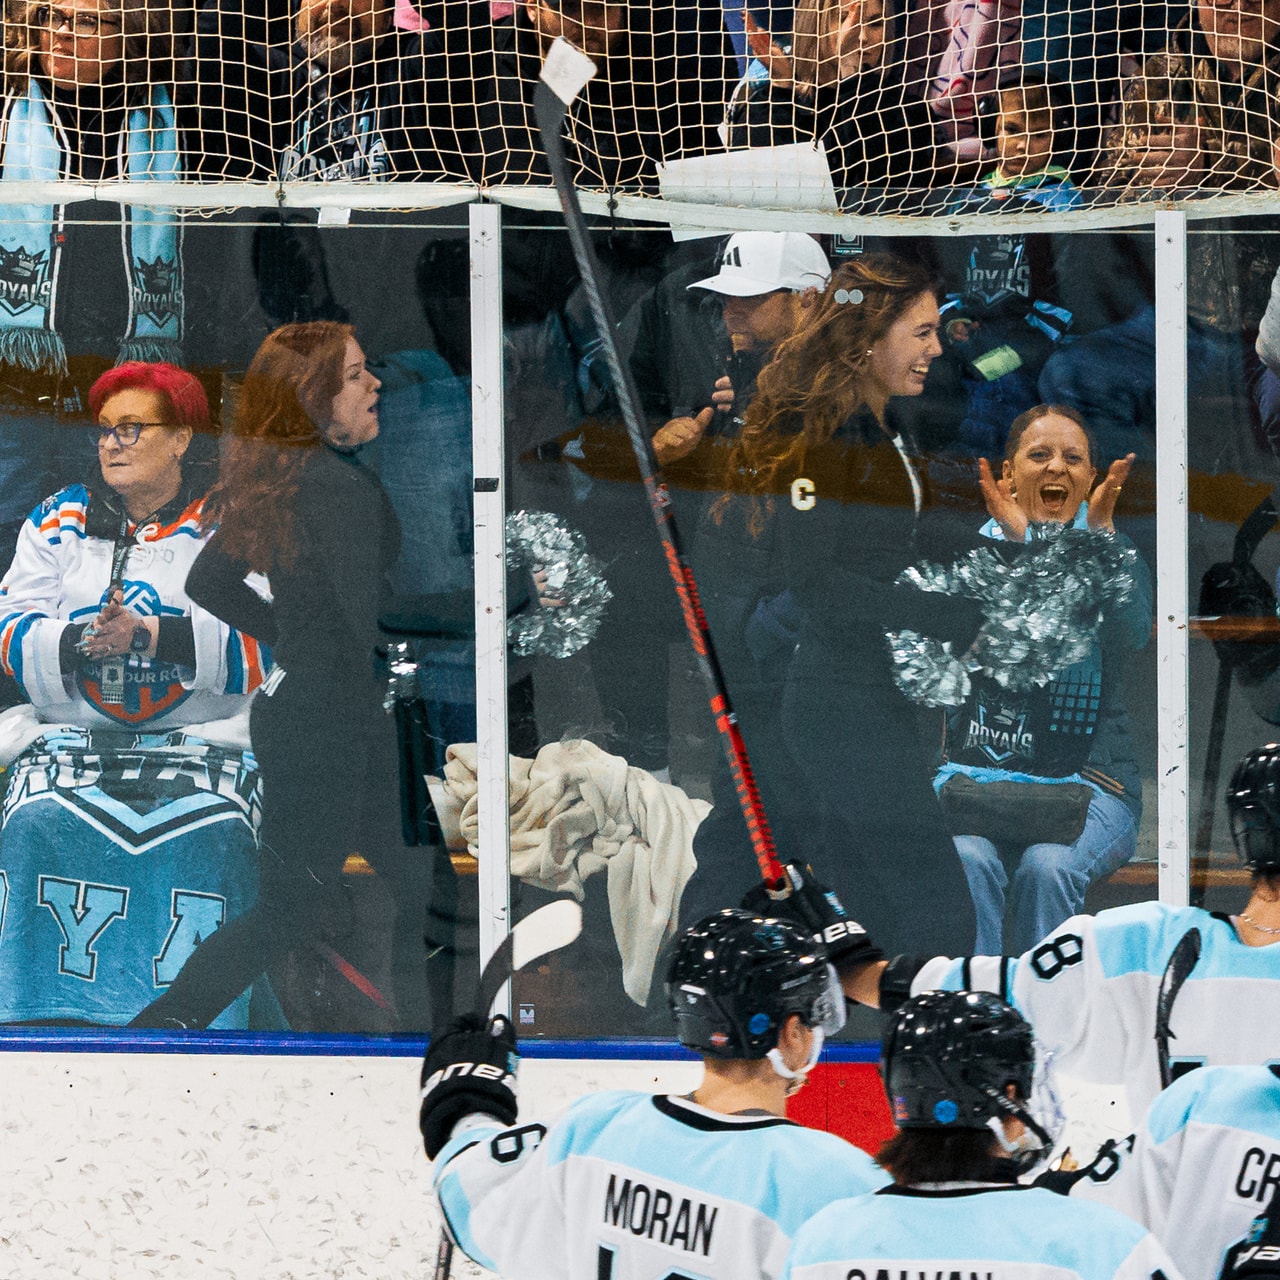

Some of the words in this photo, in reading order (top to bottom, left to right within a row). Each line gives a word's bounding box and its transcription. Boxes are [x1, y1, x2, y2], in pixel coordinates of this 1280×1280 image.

[0, 279, 51, 308] OYALS
[791, 478, 816, 511] C
[963, 720, 1034, 758] ROYALS
[604, 1173, 718, 1257] MORAN
